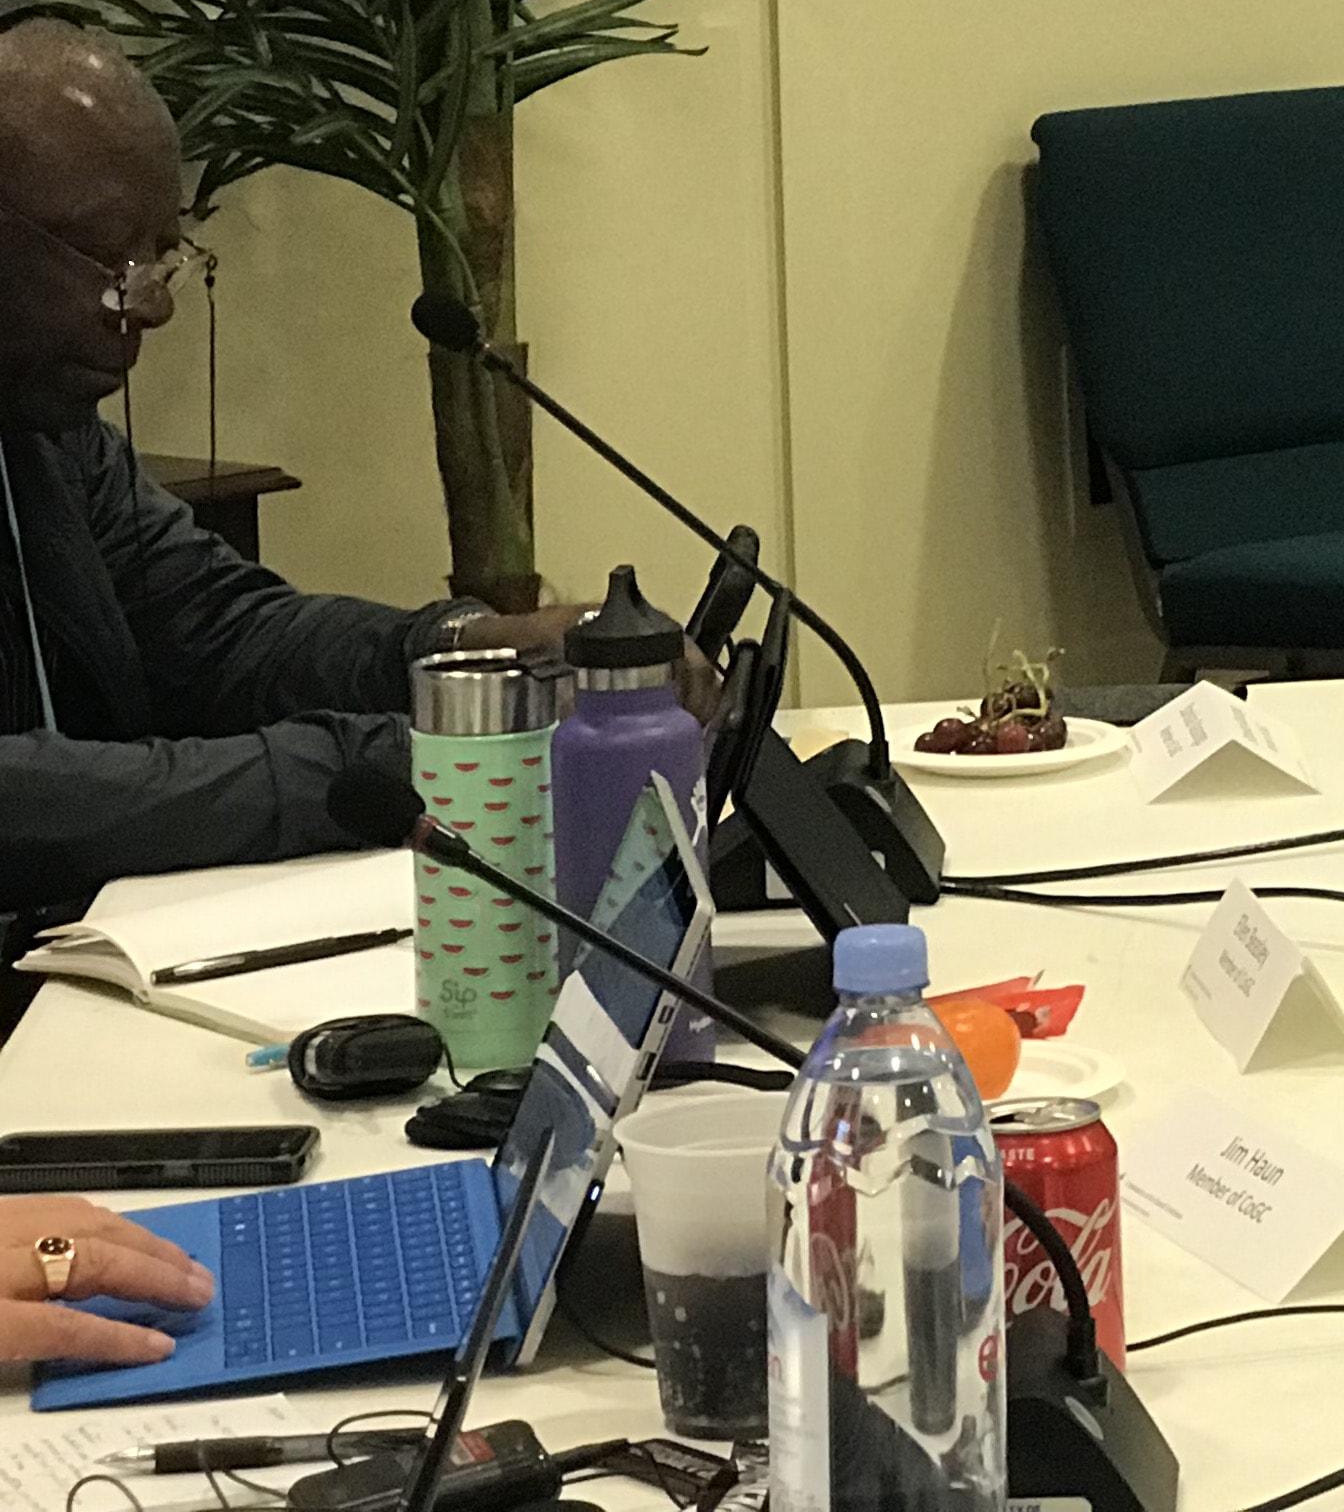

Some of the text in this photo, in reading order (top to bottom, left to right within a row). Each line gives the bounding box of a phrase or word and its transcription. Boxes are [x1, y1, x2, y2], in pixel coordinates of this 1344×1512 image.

[1219, 1135, 1284, 1186] Jim Haun
[1185, 1163, 1231, 1200] Member
[1225, 1190, 1247, 1206] of
[1237, 1194, 1272, 1224] CoGC
